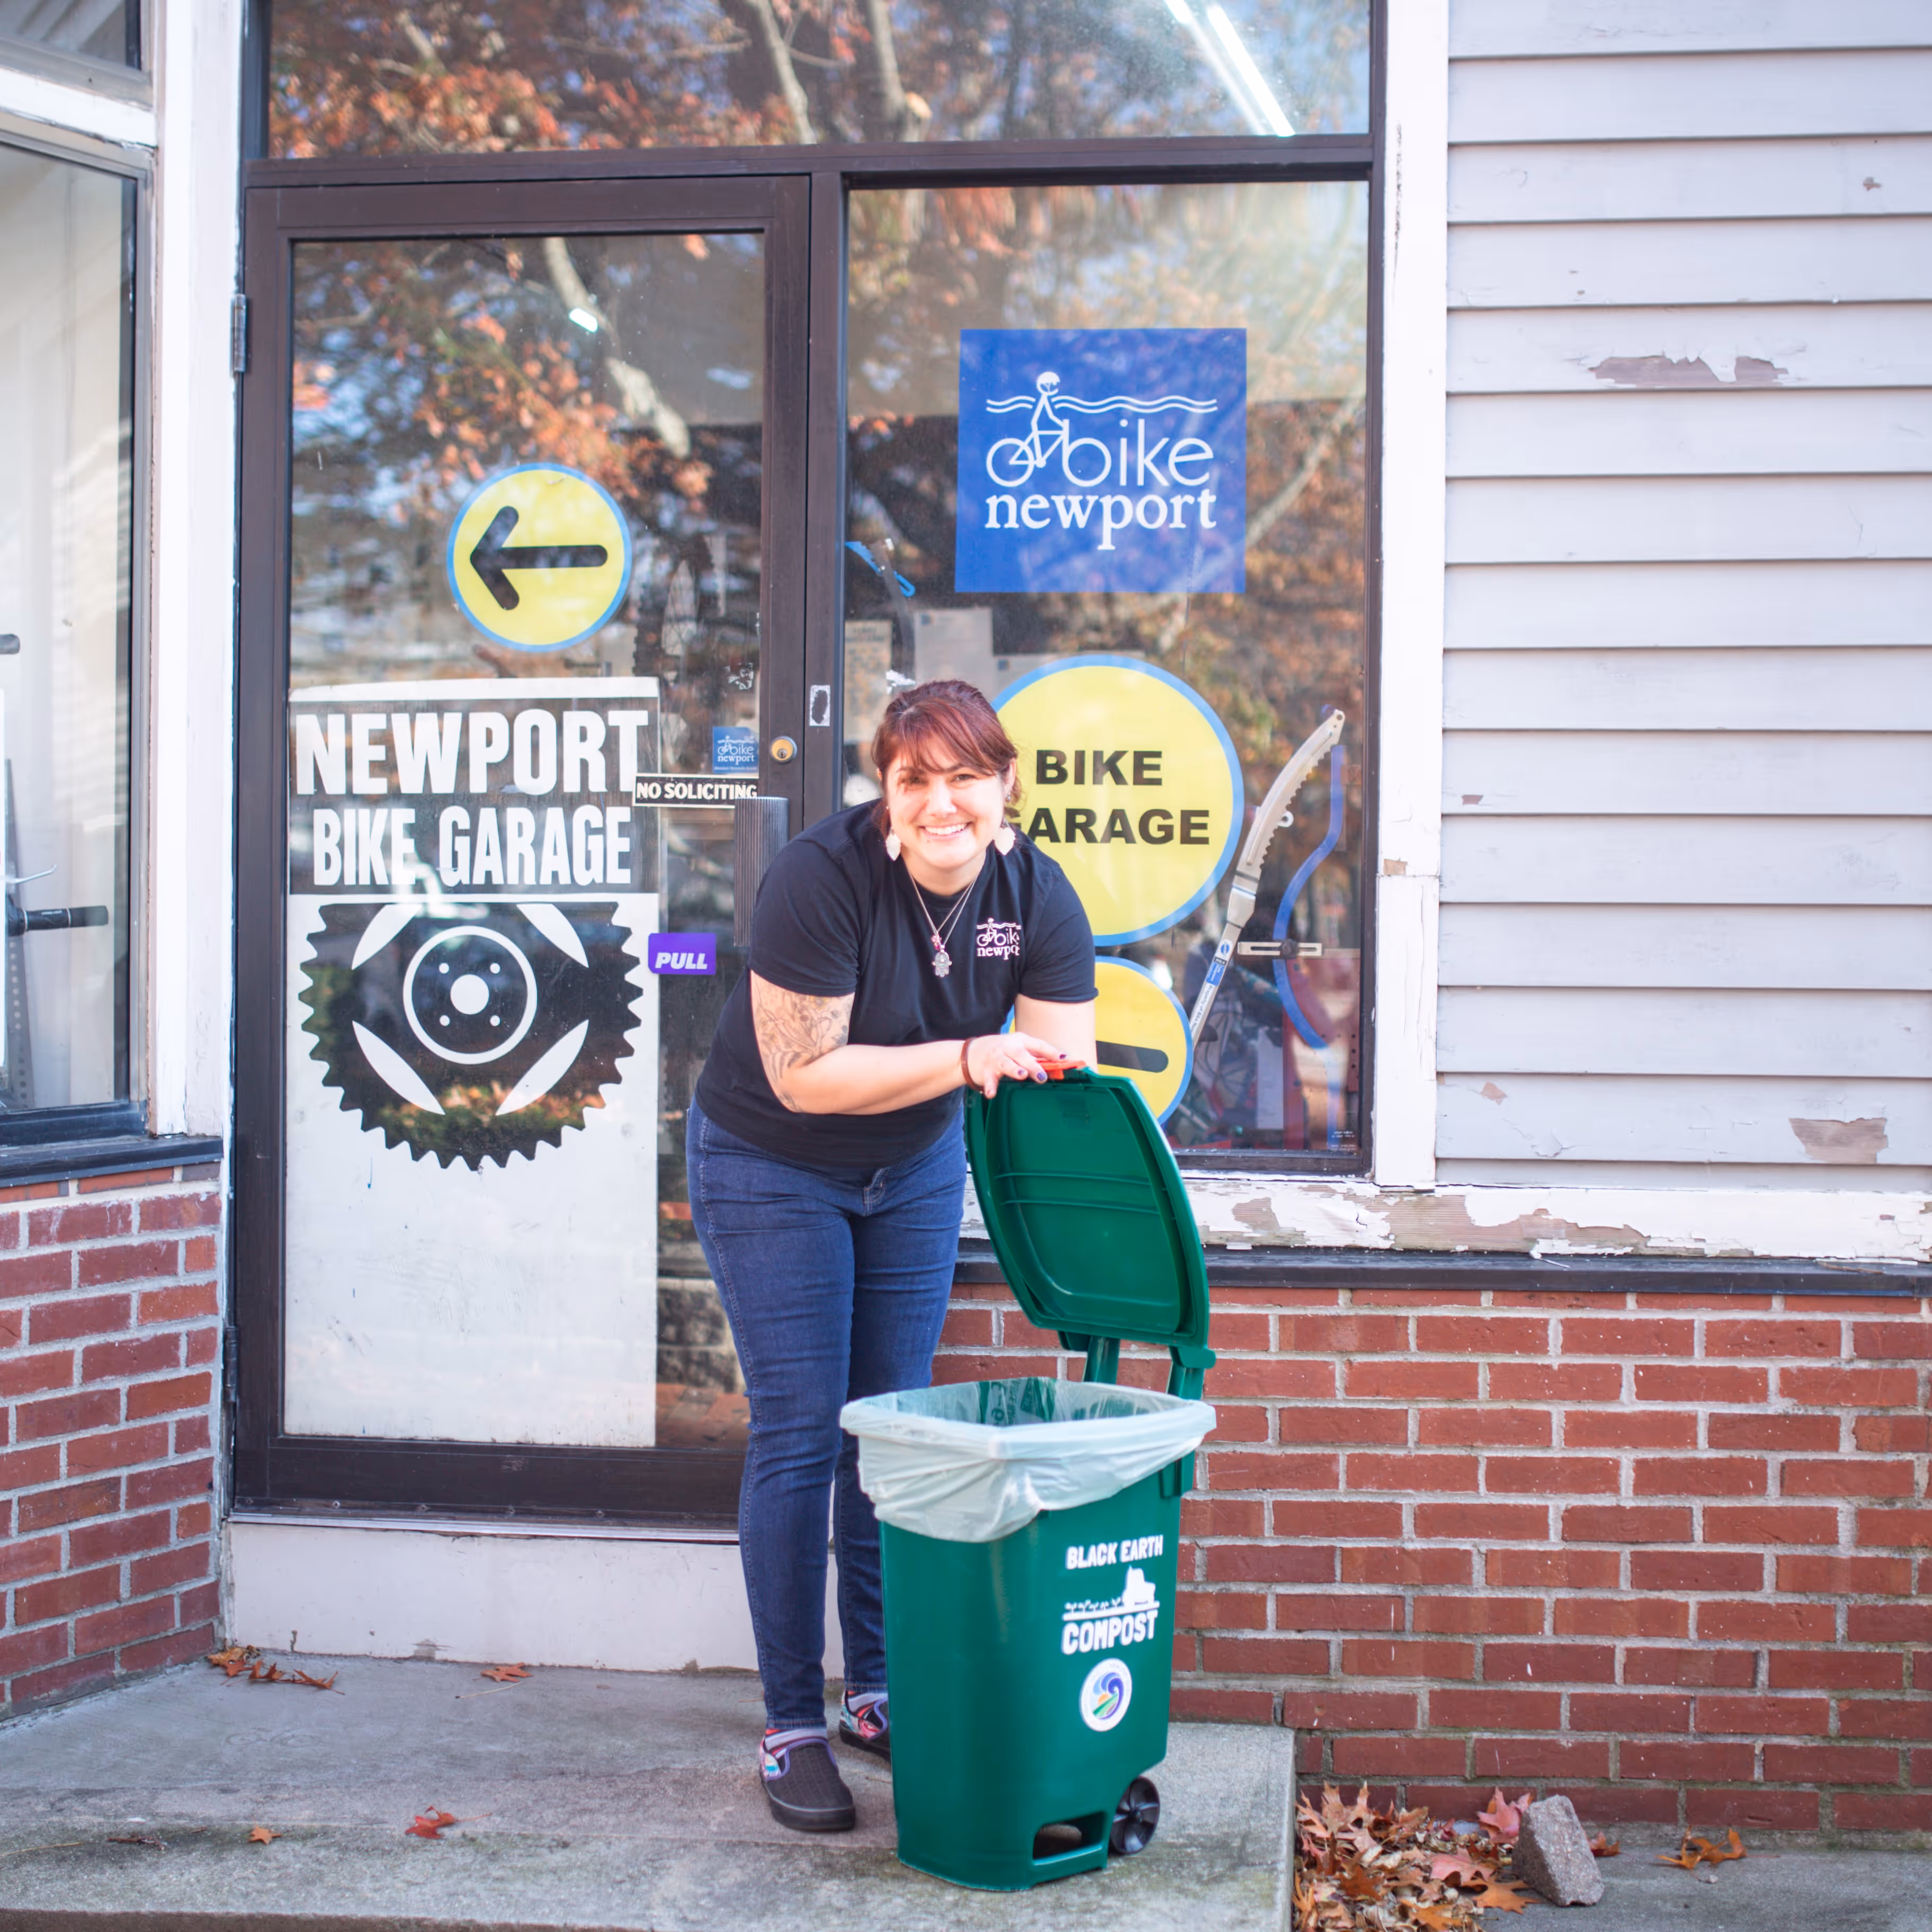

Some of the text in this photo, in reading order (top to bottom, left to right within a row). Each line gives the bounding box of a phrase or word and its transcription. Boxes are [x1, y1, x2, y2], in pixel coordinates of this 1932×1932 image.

[1062, 418, 1214, 487] bike
[985, 488, 1217, 550] newport
[296, 709, 648, 795] NEWPORT
[718, 755, 755, 765] newport
[729, 741, 755, 756] bike
[1036, 749, 1162, 786] BIKE
[636, 782, 757, 800] NO SOLICITING
[314, 804, 631, 887] BIKE GARAGE
[655, 952, 708, 970] PULL
[1066, 1535, 1164, 1569] BLACK EARTH
[1062, 1609, 1159, 1656] COMPOST
